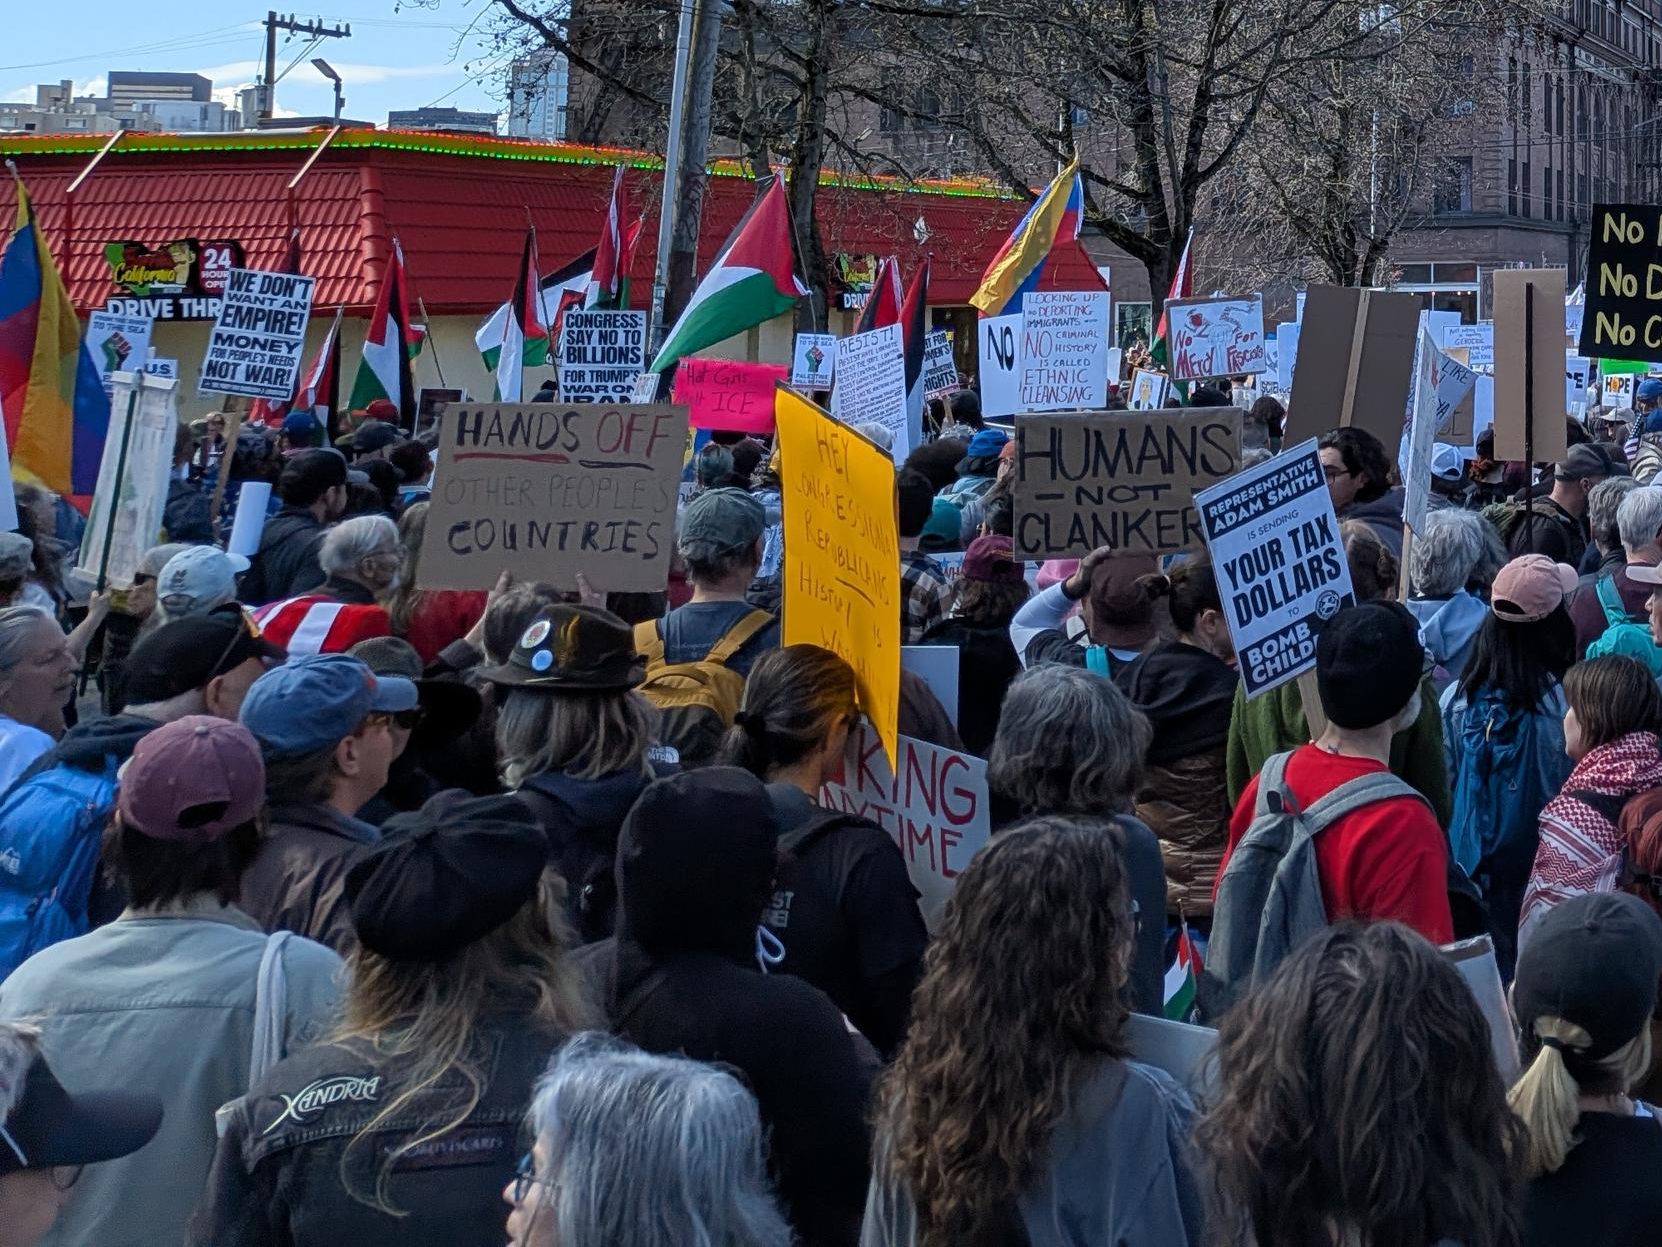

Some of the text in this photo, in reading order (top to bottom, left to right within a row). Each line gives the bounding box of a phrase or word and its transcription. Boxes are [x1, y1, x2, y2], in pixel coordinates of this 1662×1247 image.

[1603, 212, 1645, 244] No
[204, 249, 232, 269] 24
[113, 263, 177, 284] California
[229, 271, 314, 299] WE DON'T
[1600, 262, 1638, 298] No
[107, 299, 174, 318] DRIVE
[227, 293, 308, 311] WANT AN
[1028, 294, 1100, 304] LOCKING UP
[220, 304, 305, 336] EMPIRE!
[566, 314, 643, 328] CONGRESS:
[1038, 305, 1092, 317] DEPORTING
[1027, 318, 1081, 328] IMMIGRANTS
[1595, 311, 1636, 346] No
[214, 332, 301, 354] MONEY
[566, 330, 641, 345] SAY NO TO
[840, 327, 894, 355] RESIST!
[987, 324, 1015, 371] NO
[1025, 331, 1053, 359] NO
[1055, 344, 1098, 354] HISTORY
[1174, 330, 1192, 351] No
[1235, 332, 1257, 345] For
[209, 347, 227, 359] FOR
[267, 354, 296, 367] NEEDS
[566, 346, 641, 364] BILLIONS
[1040, 359, 1048, 368] IS
[205, 360, 292, 387] NOT WAR!
[564, 370, 640, 383] FOR TRUMP'S
[1025, 368, 1088, 385] ETHNIC
[1442, 360, 1472, 384] LIKE
[563, 385, 609, 393] WAR
[1022, 385, 1093, 405] CLEANSING
[712, 391, 757, 414] ICE
[456, 411, 675, 458] HANDS OFF
[815, 419, 849, 484] HEY
[1018, 423, 1235, 481] HUMANS
[444, 476, 535, 506] OTHER
[1075, 484, 1171, 505] NOT
[1209, 458, 1315, 518] REPRESENTATIVE
[1213, 471, 1319, 533] ADAM SMITH
[1248, 509, 1300, 540] IS SENDING
[447, 518, 661, 559] COUNTRIES
[1223, 513, 1335, 591] YOUR TAX
[1232, 547, 1342, 629] DOLLARS
[1288, 607, 1299, 616] TO
[1247, 622, 1311, 668] BOMB
[263, 1076, 381, 1134] XANDRIA
